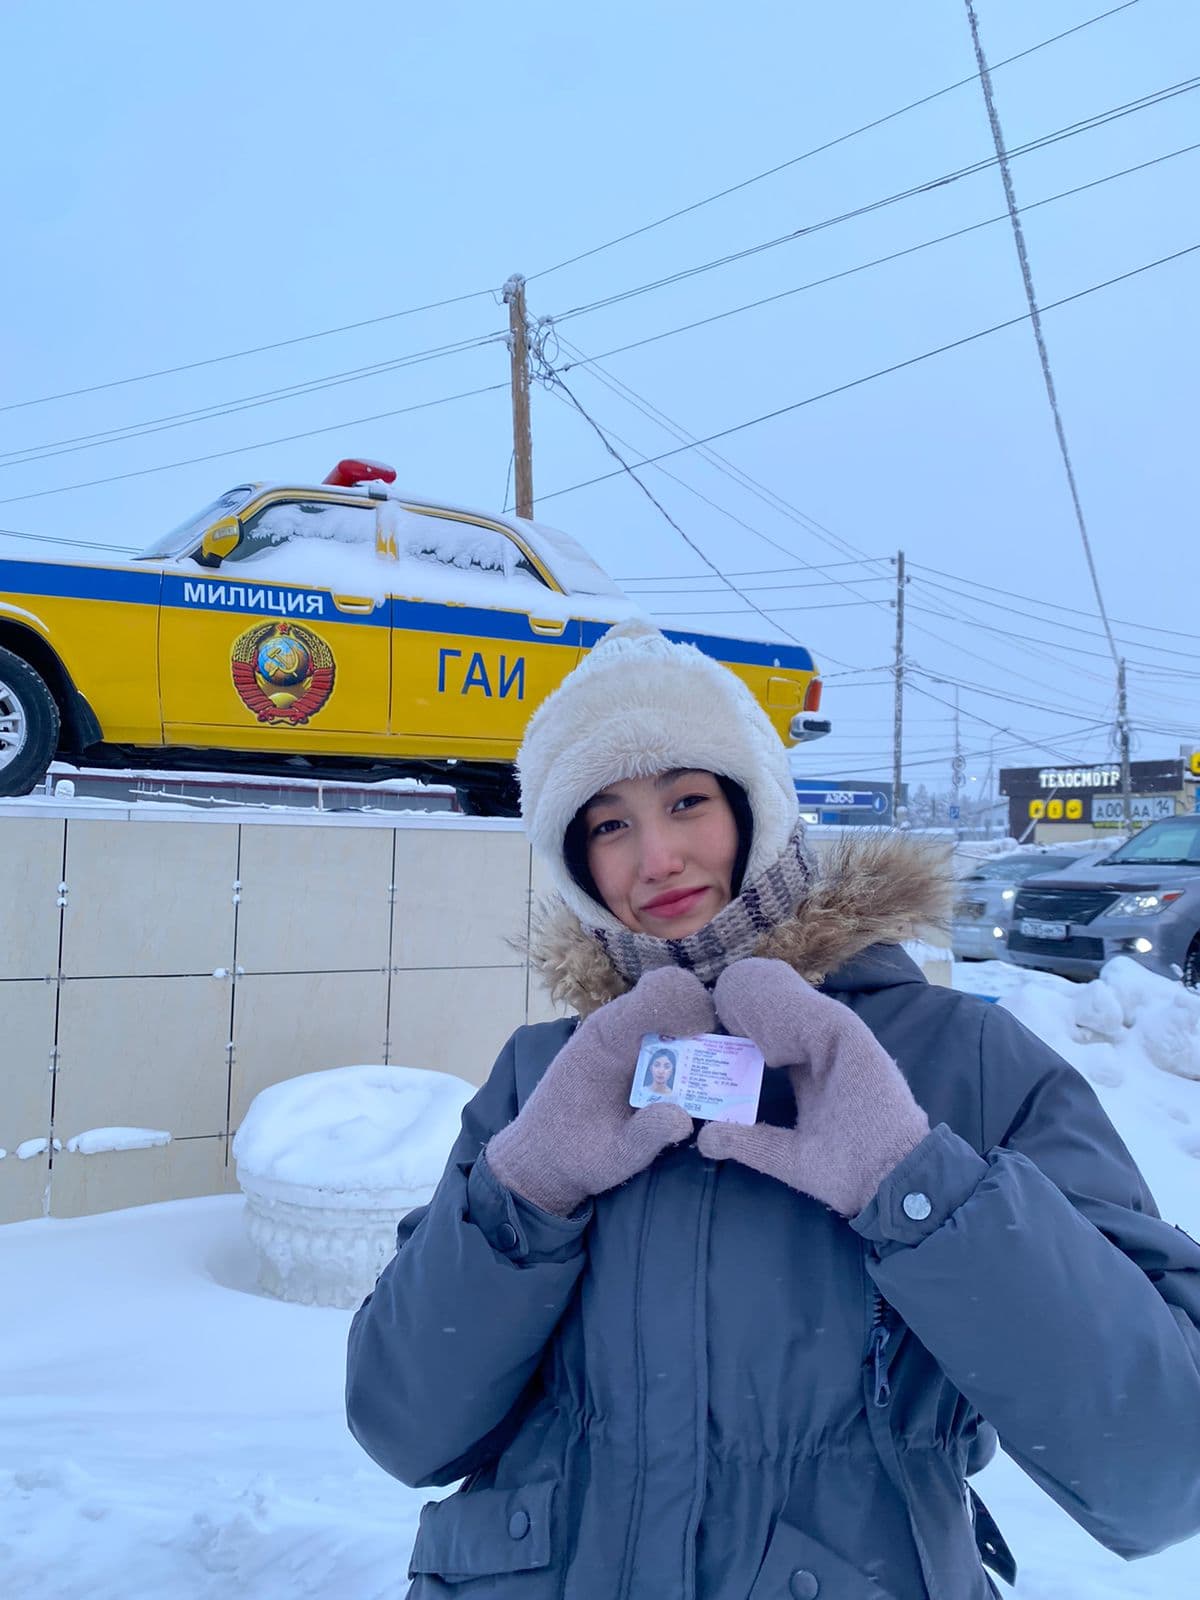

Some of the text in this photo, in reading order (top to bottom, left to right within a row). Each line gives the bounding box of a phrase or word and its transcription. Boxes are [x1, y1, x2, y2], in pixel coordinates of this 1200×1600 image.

[183, 582, 324, 615] МИЛИЦИЯ
[438, 648, 525, 700] ГАИ
[1039, 771, 1120, 788] ТЕХОСМОТР
